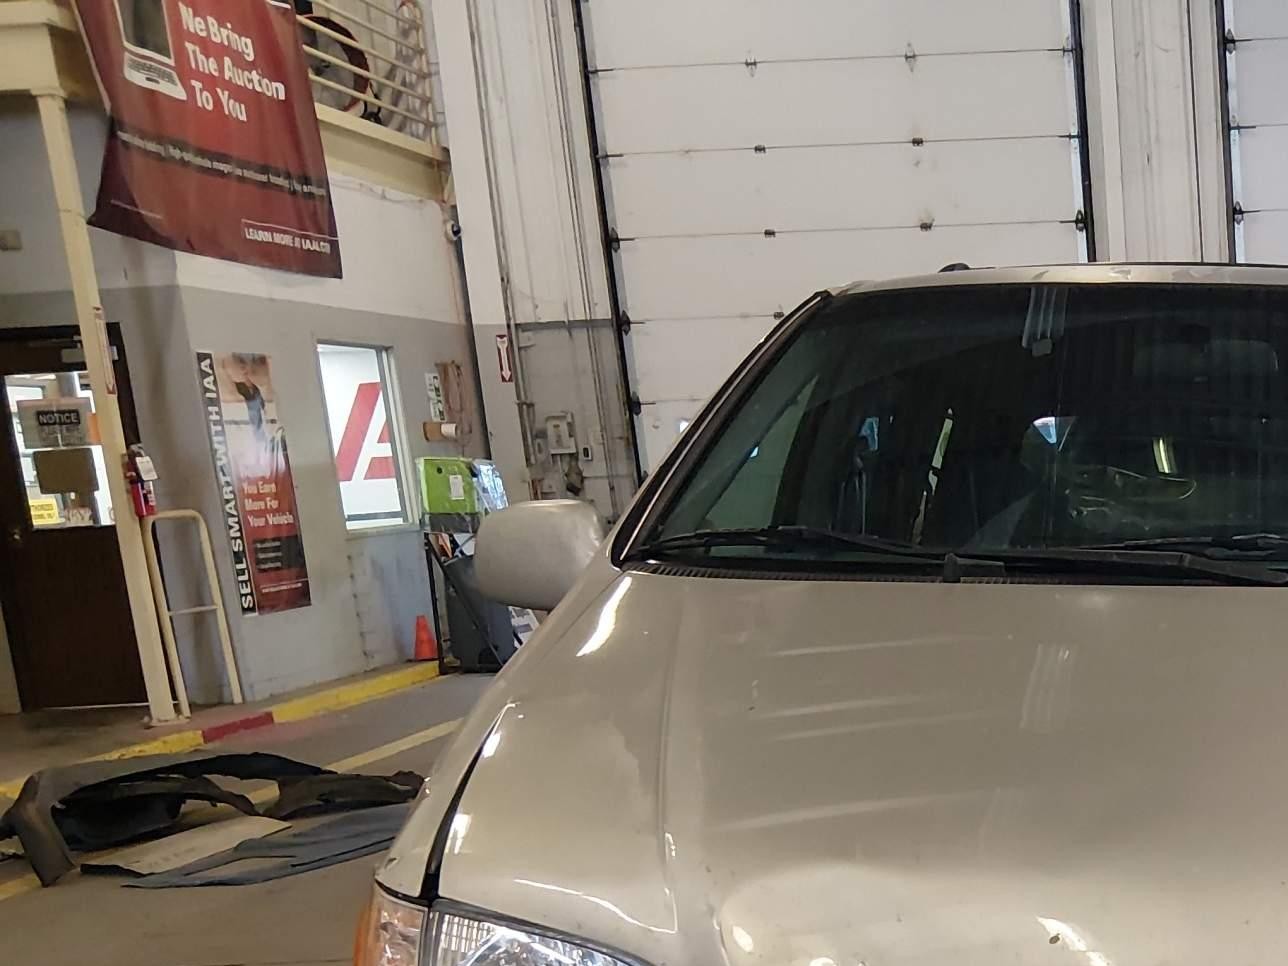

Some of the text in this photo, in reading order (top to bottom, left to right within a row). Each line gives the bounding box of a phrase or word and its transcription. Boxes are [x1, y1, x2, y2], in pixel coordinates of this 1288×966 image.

[206, 16, 254, 61] Bring
[185, 41, 285, 100] The Auction
[190, 80, 247, 121] To You
[39, 411, 78, 425] NOTICE
[200, 359, 254, 609] SELL SMART WITH IAA
